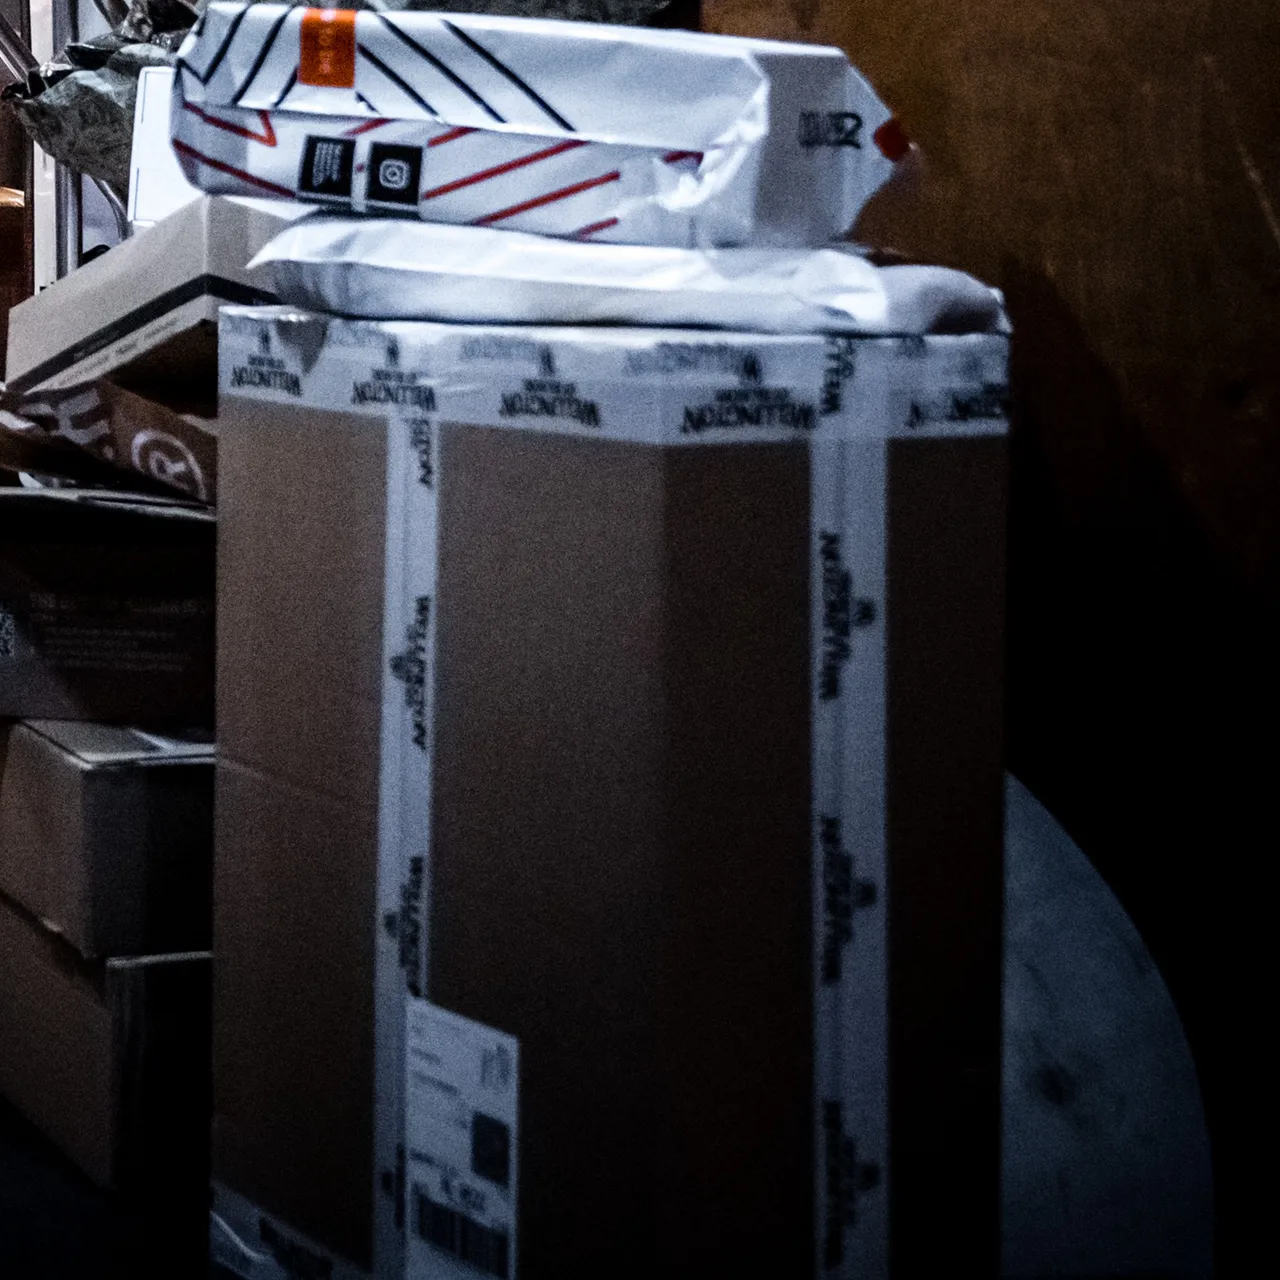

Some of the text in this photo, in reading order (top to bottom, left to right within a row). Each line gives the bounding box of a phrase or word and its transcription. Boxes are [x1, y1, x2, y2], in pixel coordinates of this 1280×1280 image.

[230, 365, 303, 398] WELLINGTON
[351, 381, 438, 412] WELLINGTON
[498, 391, 601, 428] WELLINGTON
[680, 402, 817, 433] WELLINGTON
